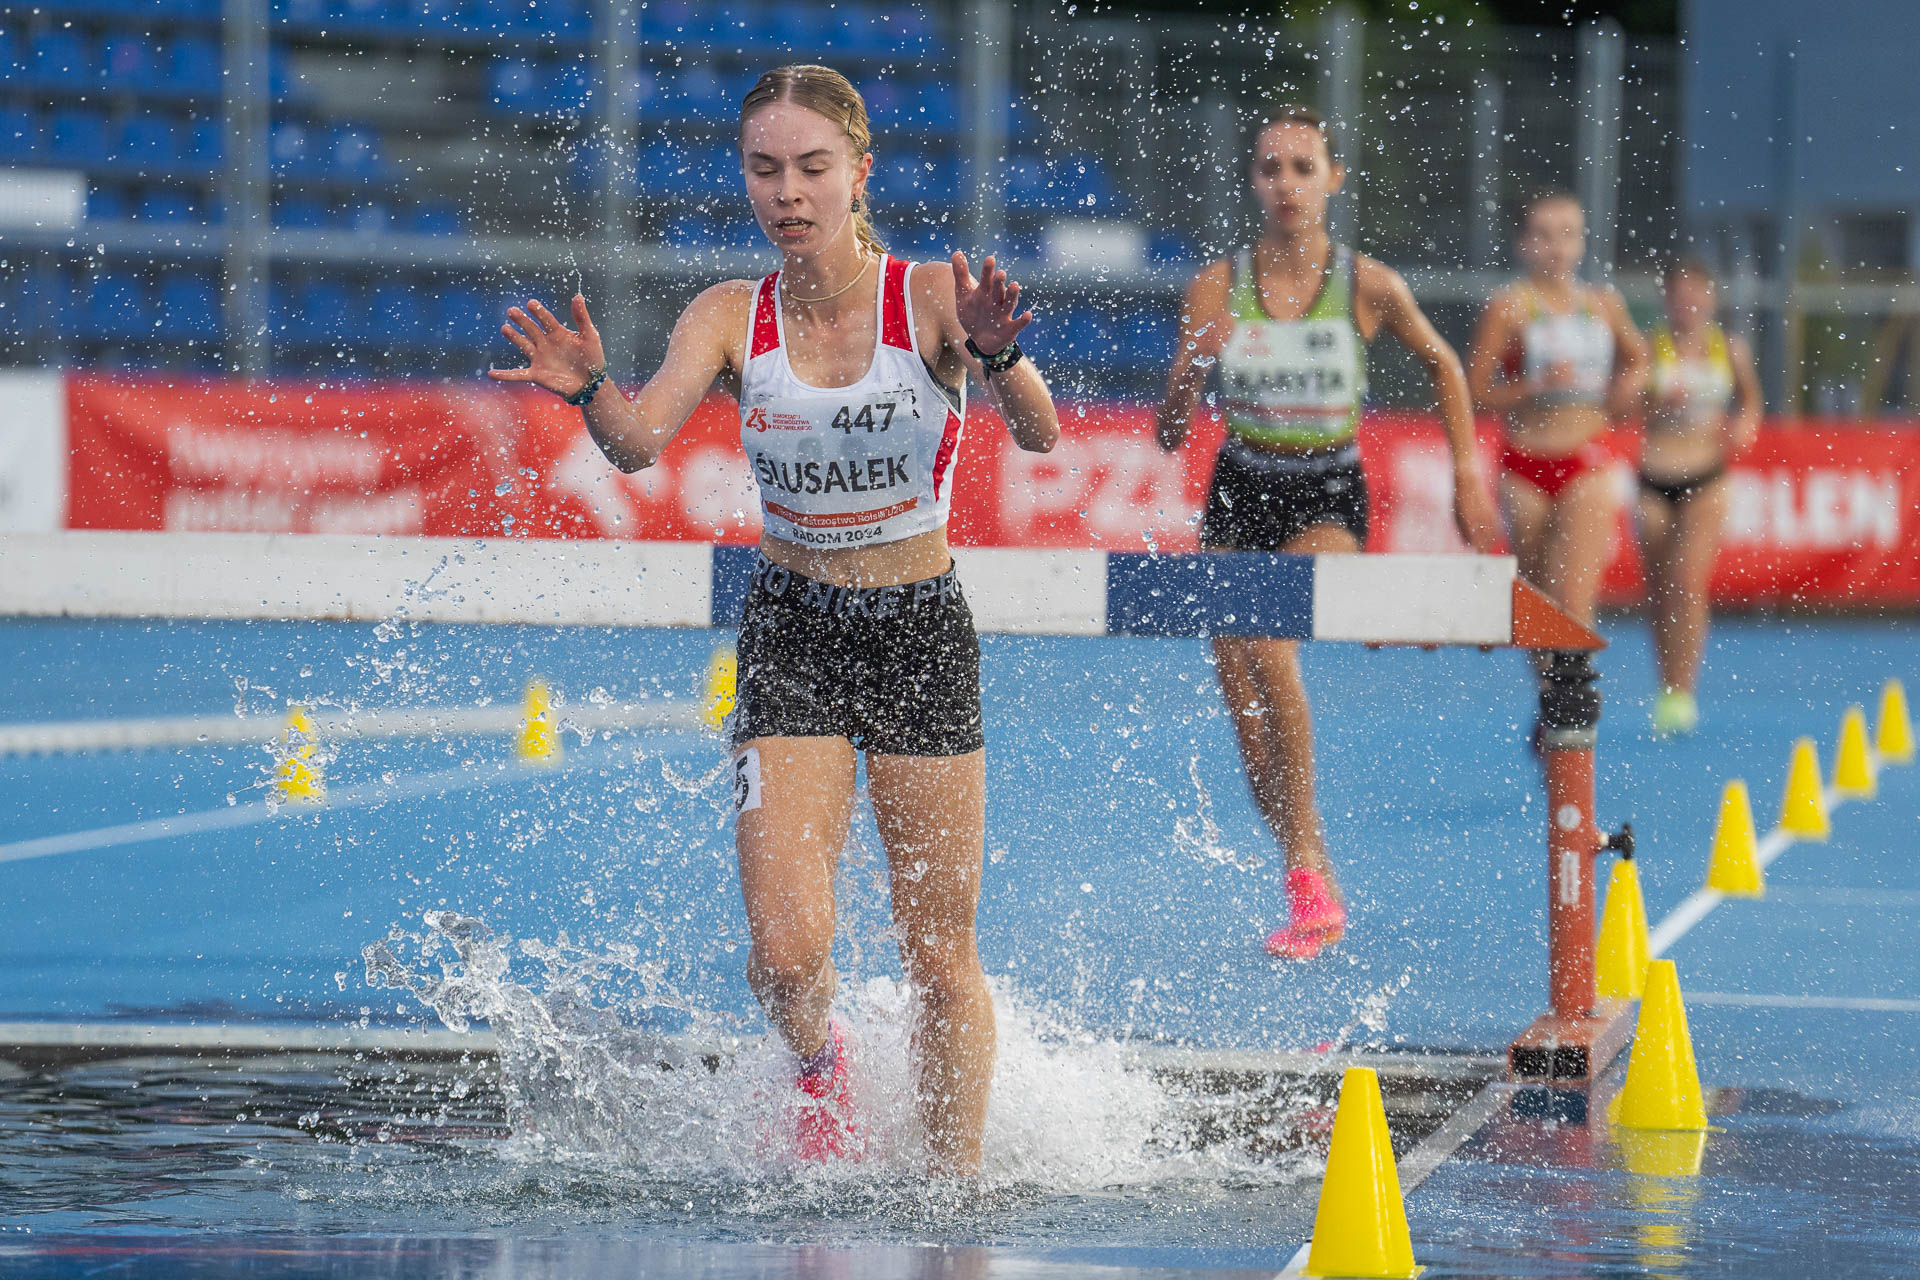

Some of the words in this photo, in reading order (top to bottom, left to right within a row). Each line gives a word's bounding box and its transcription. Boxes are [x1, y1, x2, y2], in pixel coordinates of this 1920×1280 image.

[831, 402, 896, 434] 447
[755, 452, 910, 494] ŚLUSAŁEK
[792, 527, 842, 544] RADOM
[844, 526, 883, 543] 2024
[803, 580, 904, 617] NIKE
